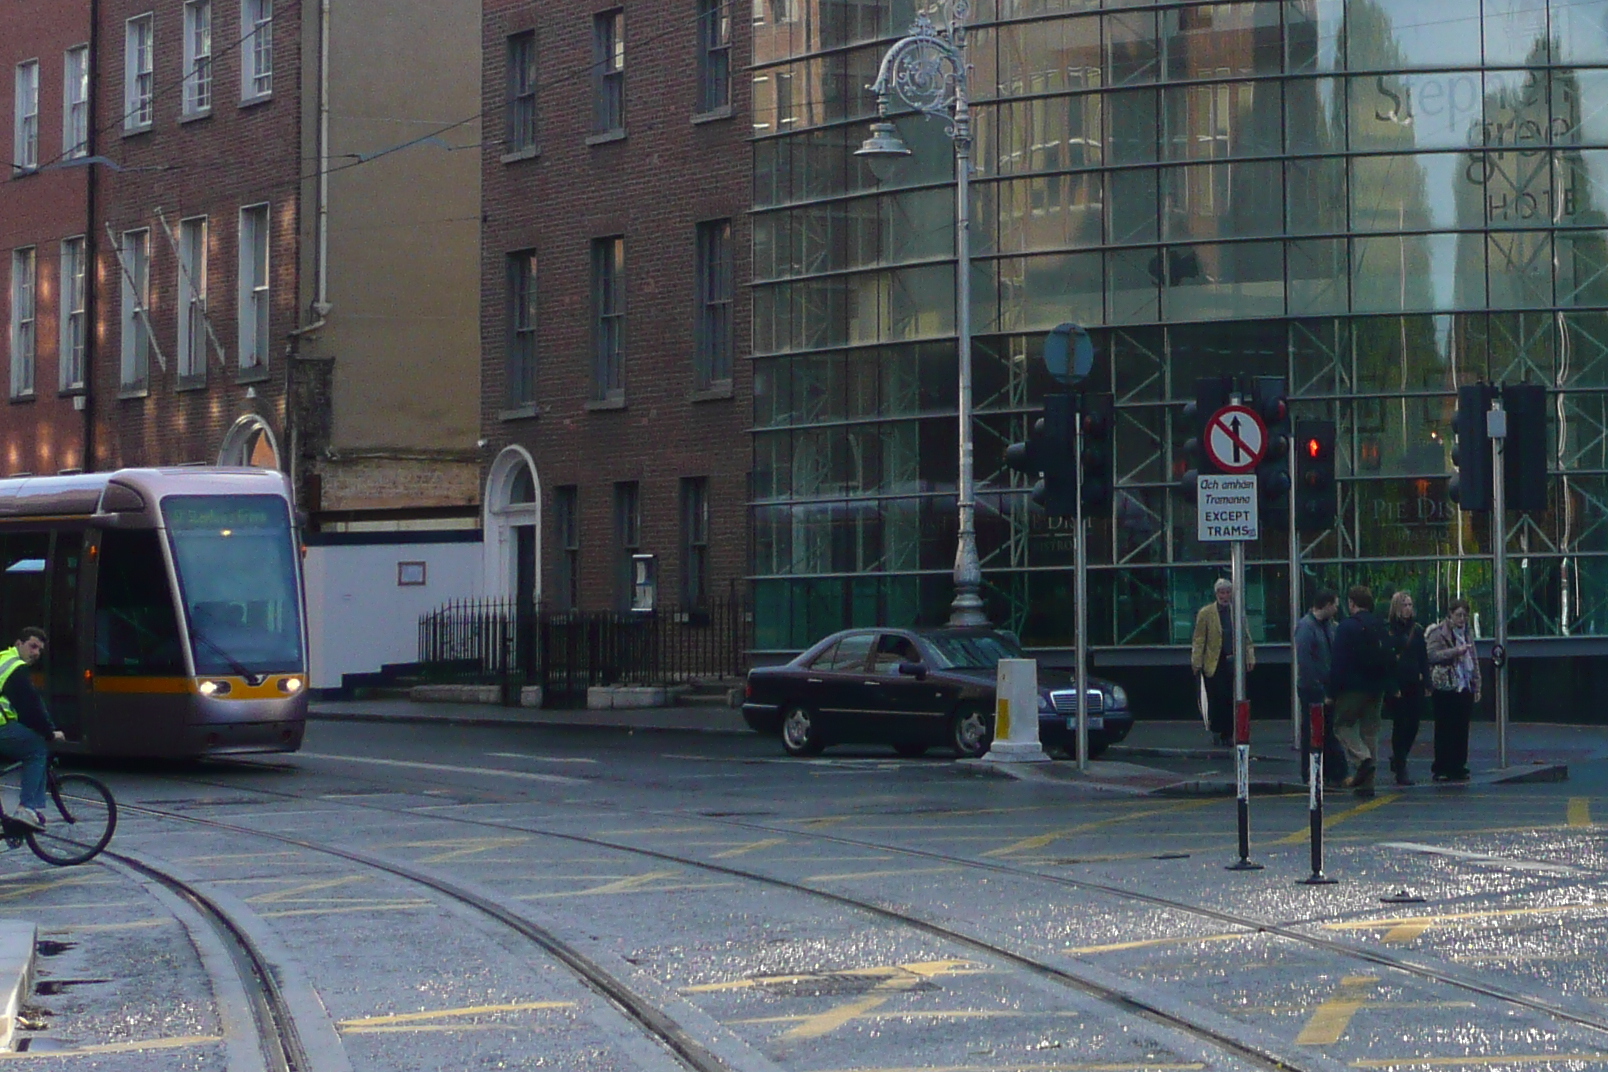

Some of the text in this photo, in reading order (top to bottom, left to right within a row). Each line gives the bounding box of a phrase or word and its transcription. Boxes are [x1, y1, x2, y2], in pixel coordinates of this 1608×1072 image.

[1200, 479, 1219, 490] Ach
[1205, 494, 1251, 505] Tramanna
[1417, 497, 1461, 519] DIS
[1205, 510, 1250, 522] EXCEPT
[1207, 525, 1249, 537] TRAMS
